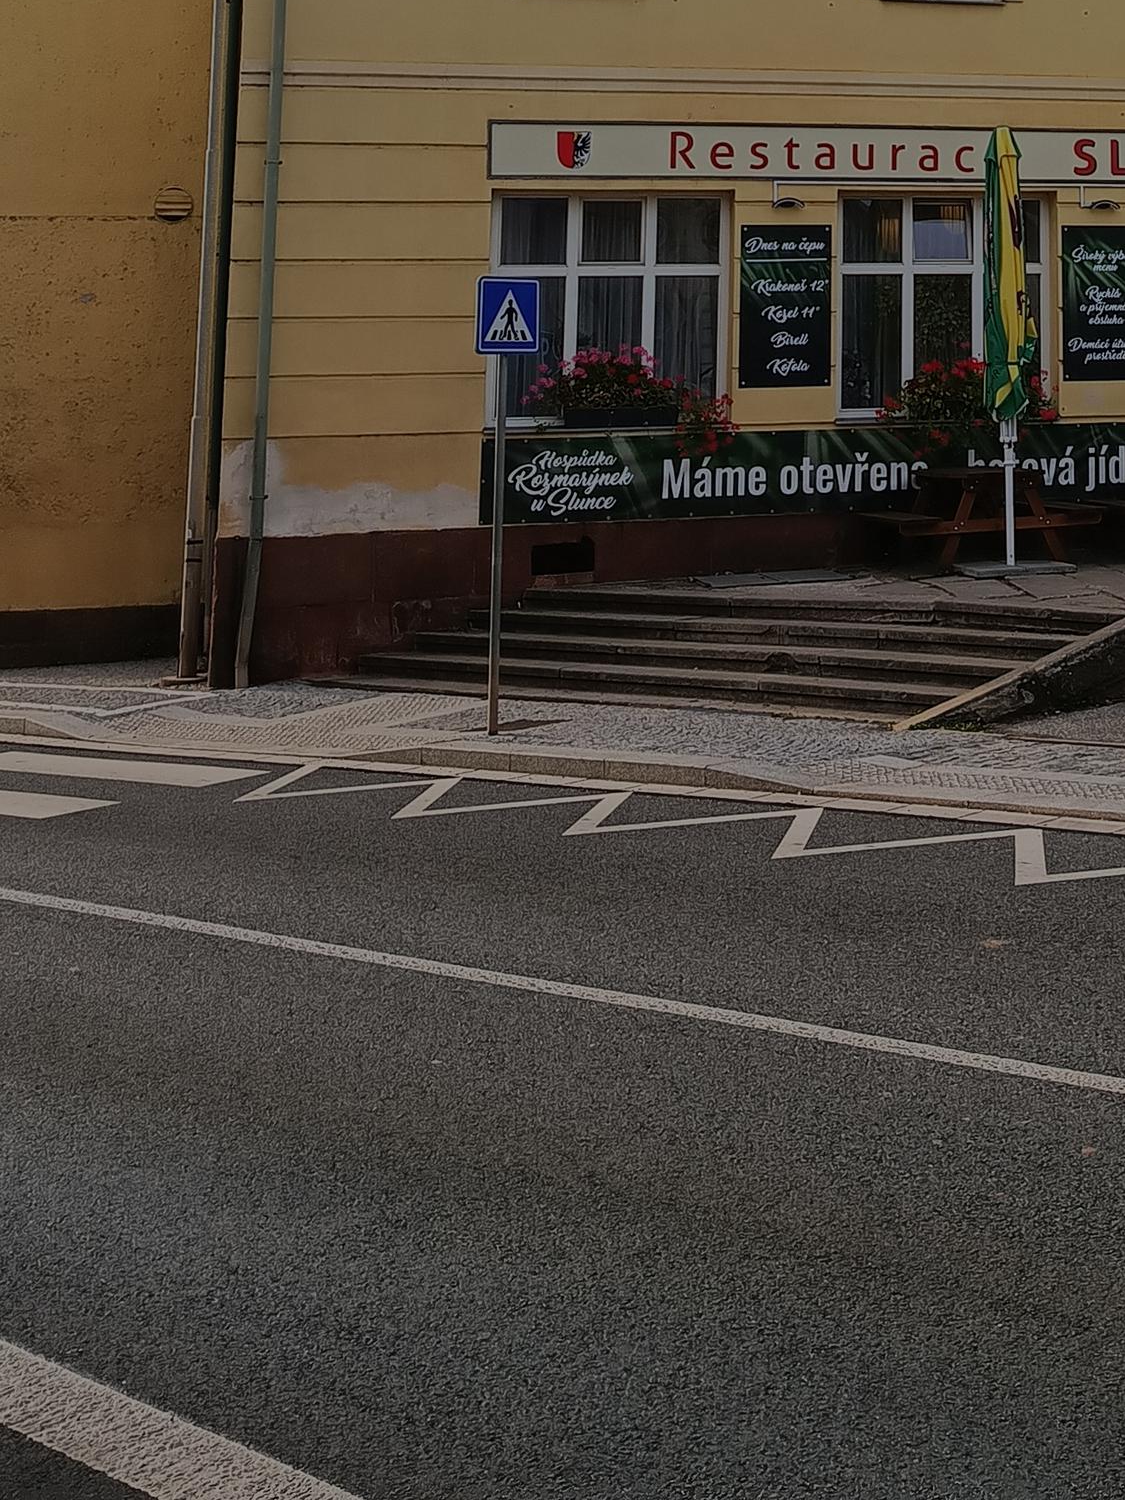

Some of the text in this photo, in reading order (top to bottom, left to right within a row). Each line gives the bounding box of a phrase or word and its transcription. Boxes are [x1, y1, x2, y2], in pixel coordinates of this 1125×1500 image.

[669, 131, 975, 173] Restaurac
[744, 236, 826, 255] Dnes na čepu
[1071, 244, 1106, 264] Široký
[1092, 263, 1119, 272] menu
[750, 278, 830, 297] Krakonoš 12°
[1084, 285, 1122, 303] Rychlá
[761, 305, 799, 324] Kozel
[1079, 304, 1087, 312] a
[1088, 314, 1125, 325] obsluha
[770, 331, 809, 349] Birell
[1067, 336, 1111, 353] Domácí
[766, 357, 811, 377] Kofola
[531, 449, 618, 473] Hospůdka
[507, 465, 634, 496] Rozmarýnek
[661, 455, 767, 500] Máme
[967, 445, 1076, 487] hvá
[530, 487, 617, 517] u Slunce
